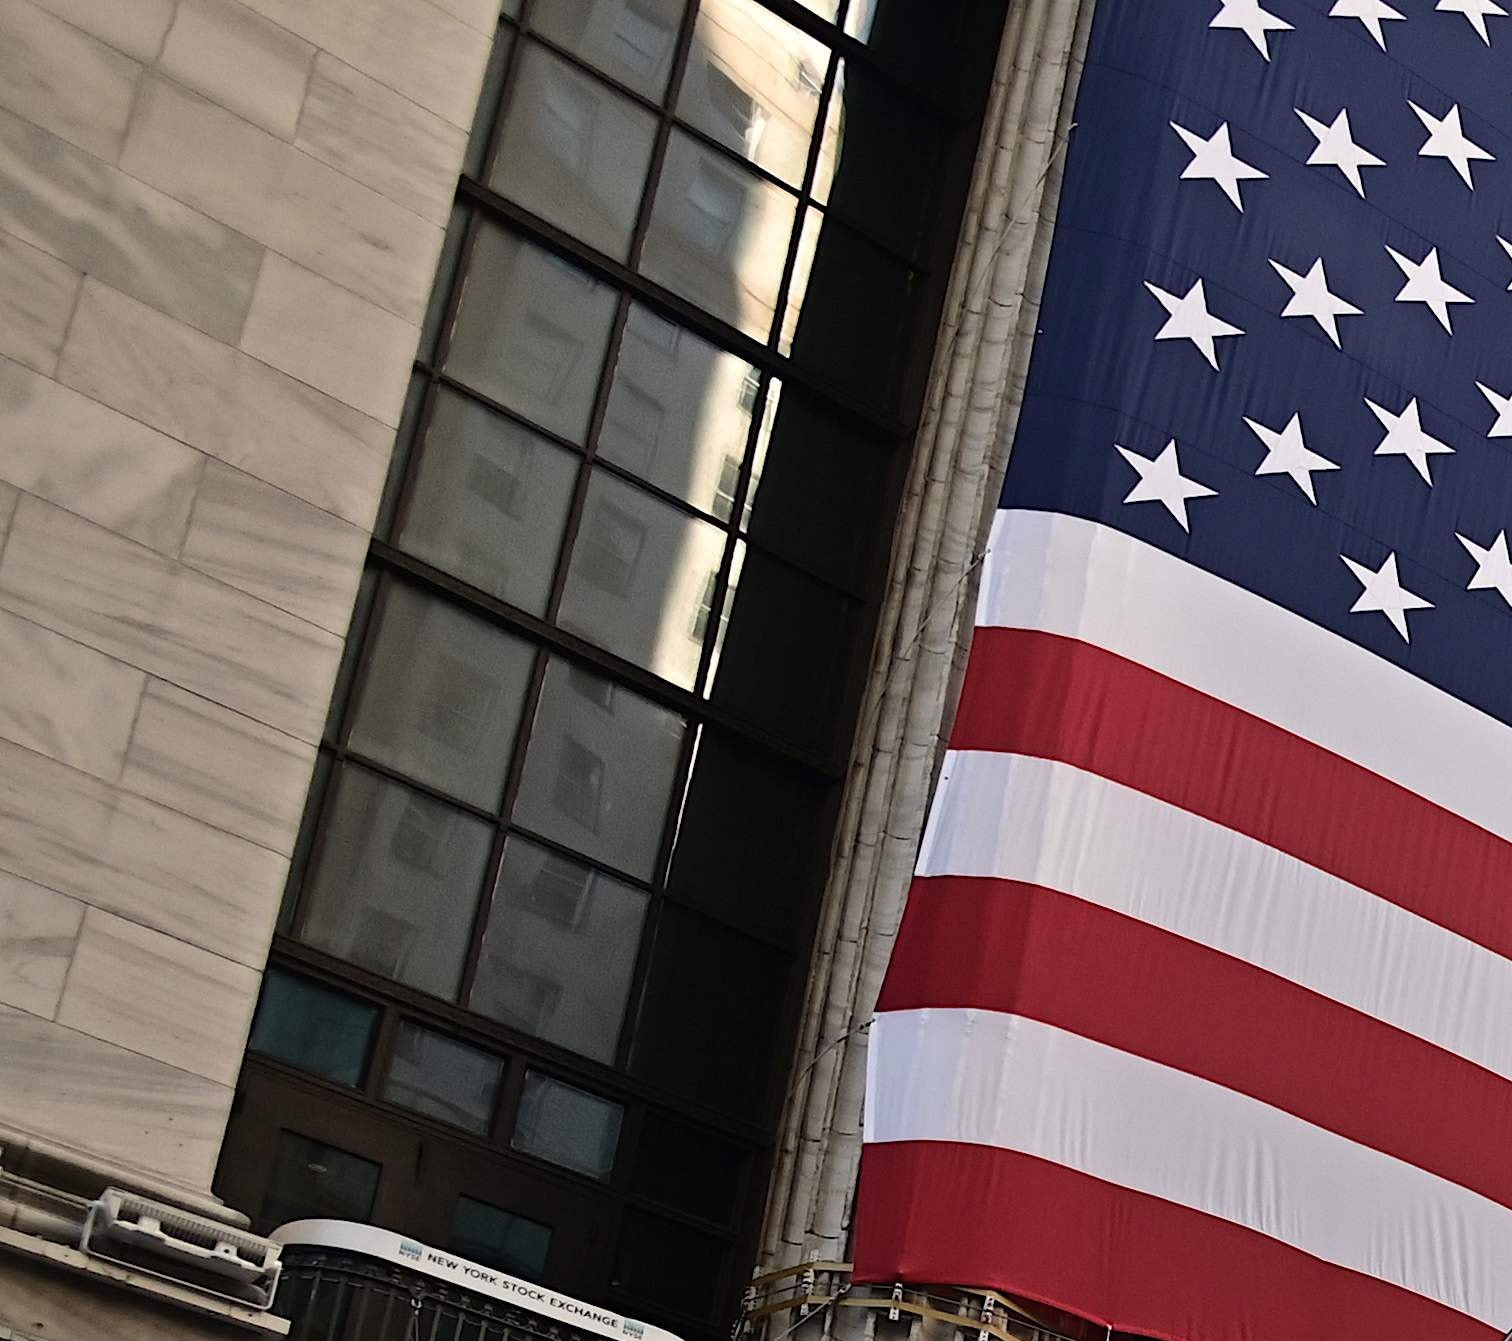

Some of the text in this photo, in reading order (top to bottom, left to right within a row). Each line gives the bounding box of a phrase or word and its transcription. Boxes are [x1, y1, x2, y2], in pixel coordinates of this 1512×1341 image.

[427, 1253, 619, 1329] NEW YORK STOCK EXCHANGE
